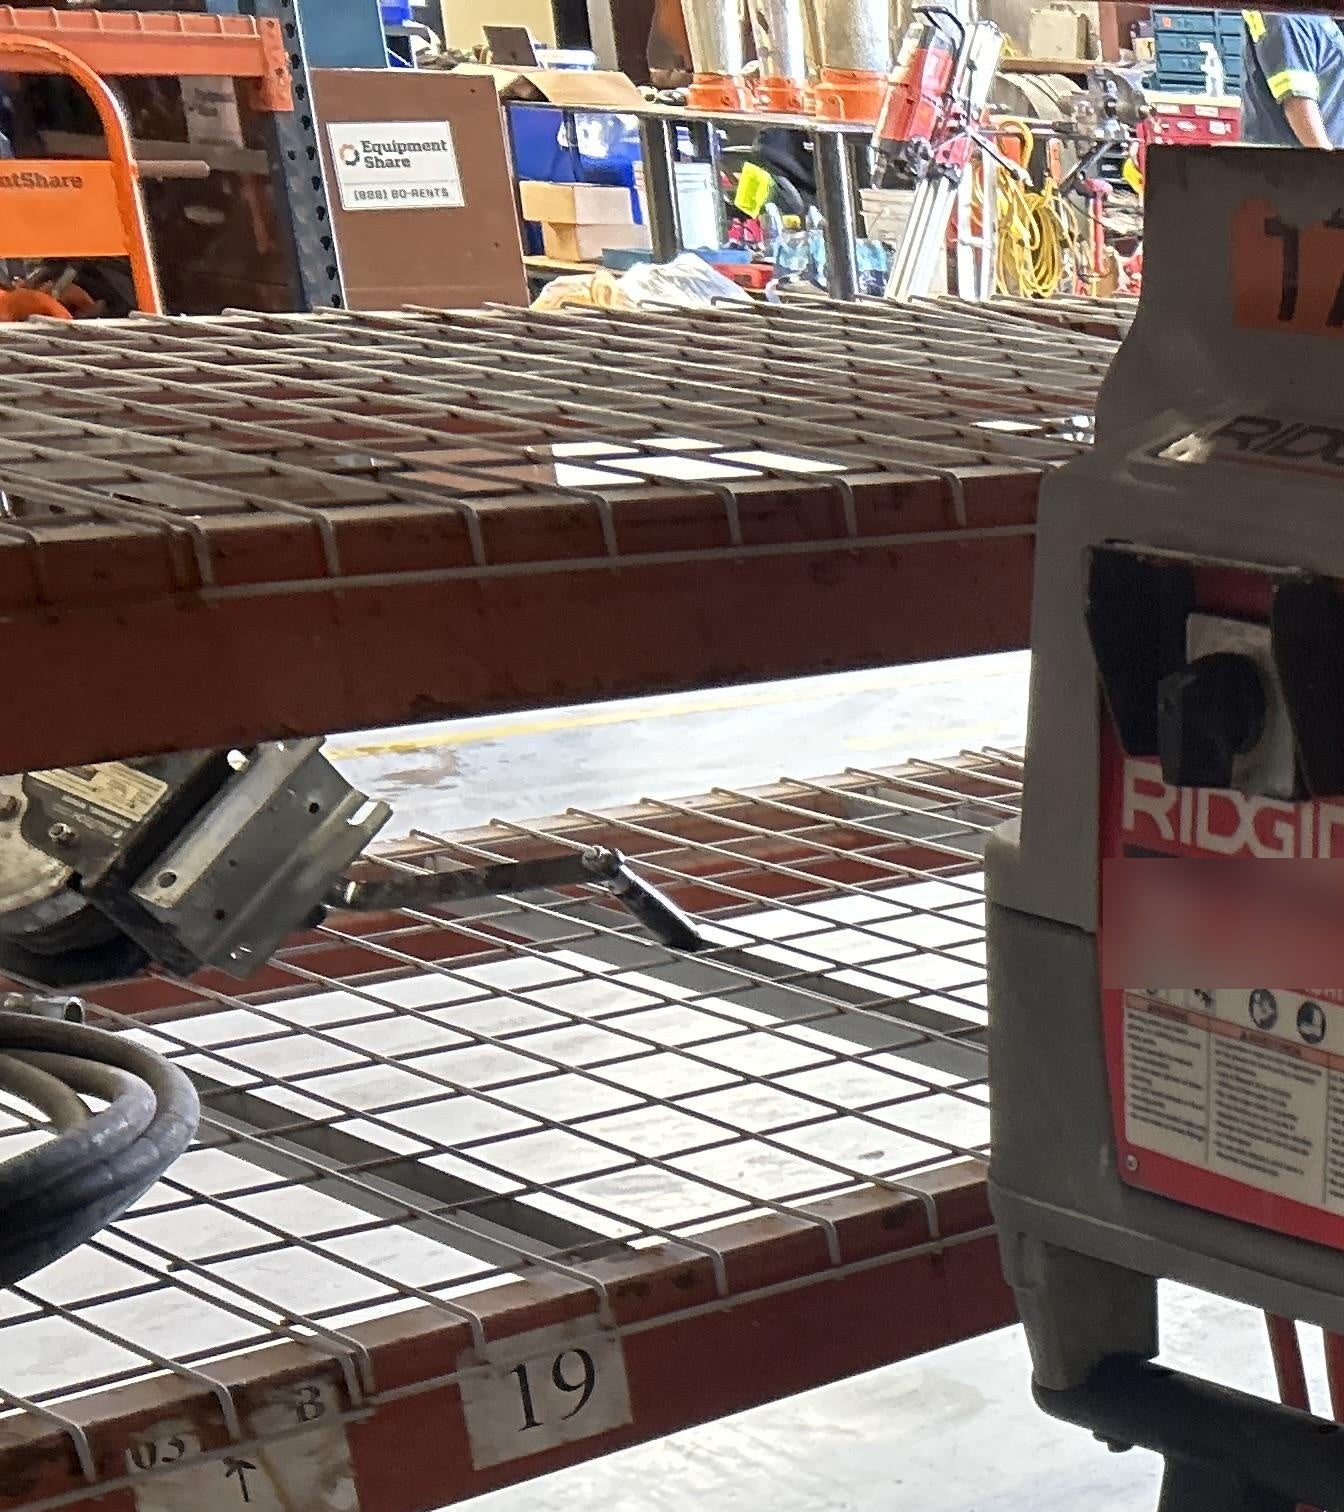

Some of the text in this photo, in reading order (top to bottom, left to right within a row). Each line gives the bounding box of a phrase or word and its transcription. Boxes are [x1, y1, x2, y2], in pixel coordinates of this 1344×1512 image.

[360, 139, 448, 155] Equipment
[363, 155, 411, 169] Share
[511, 1347, 597, 1432] 19
